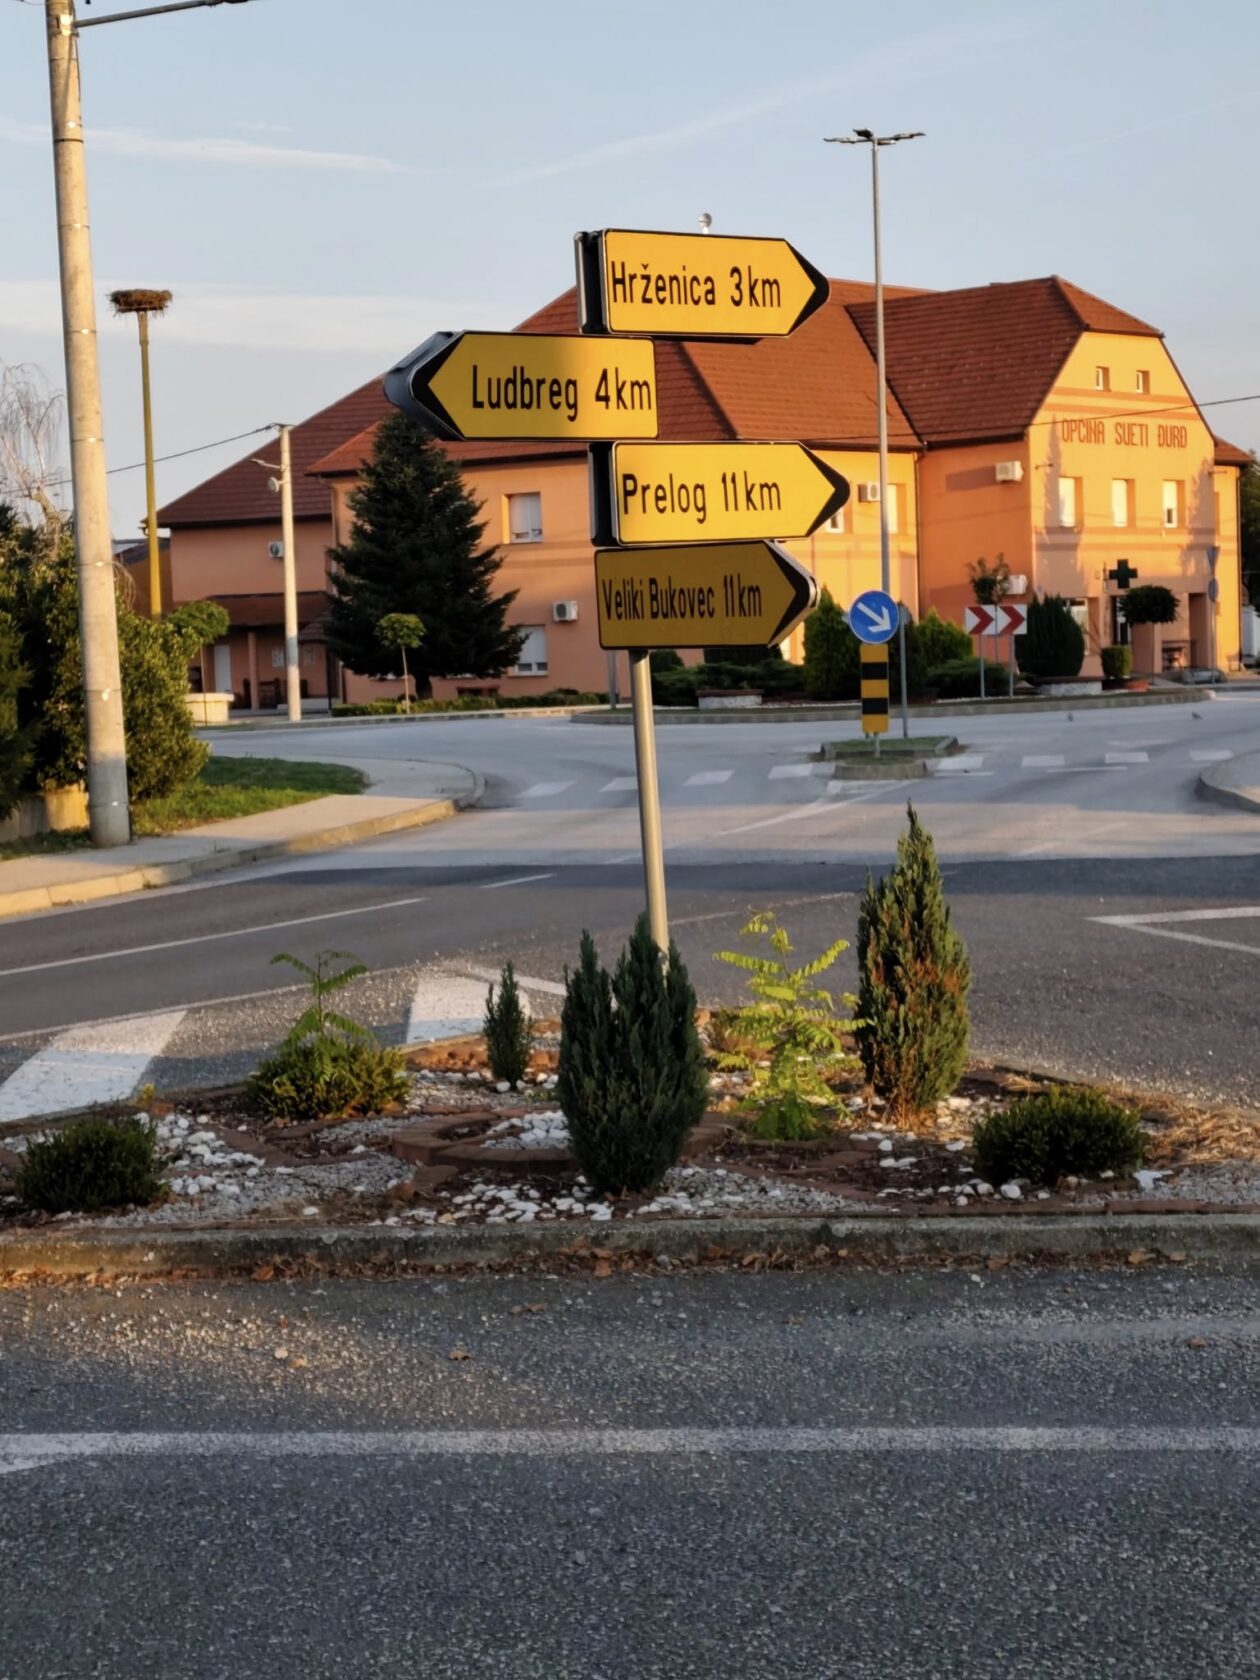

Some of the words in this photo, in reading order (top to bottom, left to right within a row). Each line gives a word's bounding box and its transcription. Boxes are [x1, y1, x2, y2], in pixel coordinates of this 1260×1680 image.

[611, 260, 715, 305] Hrženica
[729, 266, 781, 308] 3km
[472, 364, 578, 421] Ludbreg
[595, 367, 652, 411] 4km
[623, 473, 706, 523] Prelog
[721, 471, 781, 512] 11km
[602, 578, 645, 620] Veliki
[649, 576, 715, 620] Bukovec
[723, 573, 762, 617] 11km
